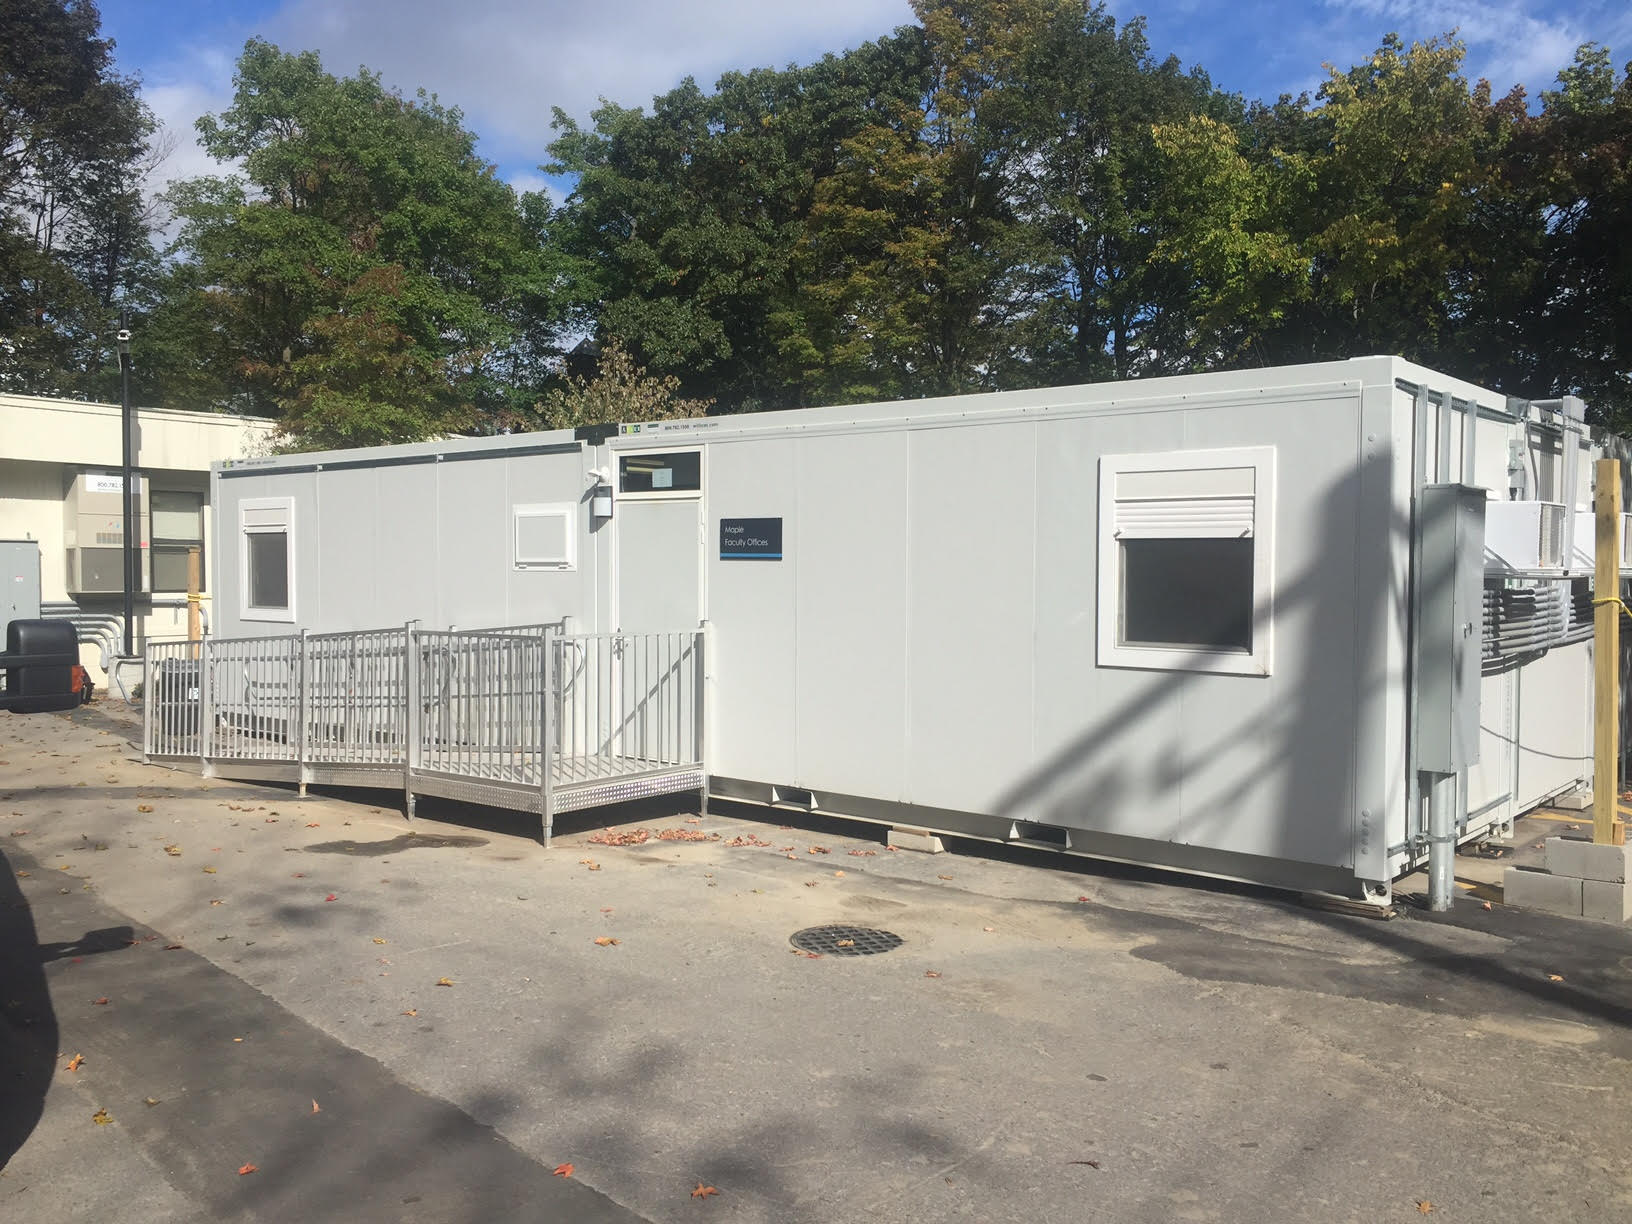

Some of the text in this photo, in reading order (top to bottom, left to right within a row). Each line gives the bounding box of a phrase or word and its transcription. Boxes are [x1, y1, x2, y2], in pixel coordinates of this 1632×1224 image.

[724, 526, 744, 535] Maple
[724, 538, 769, 548] Faculty Offices
